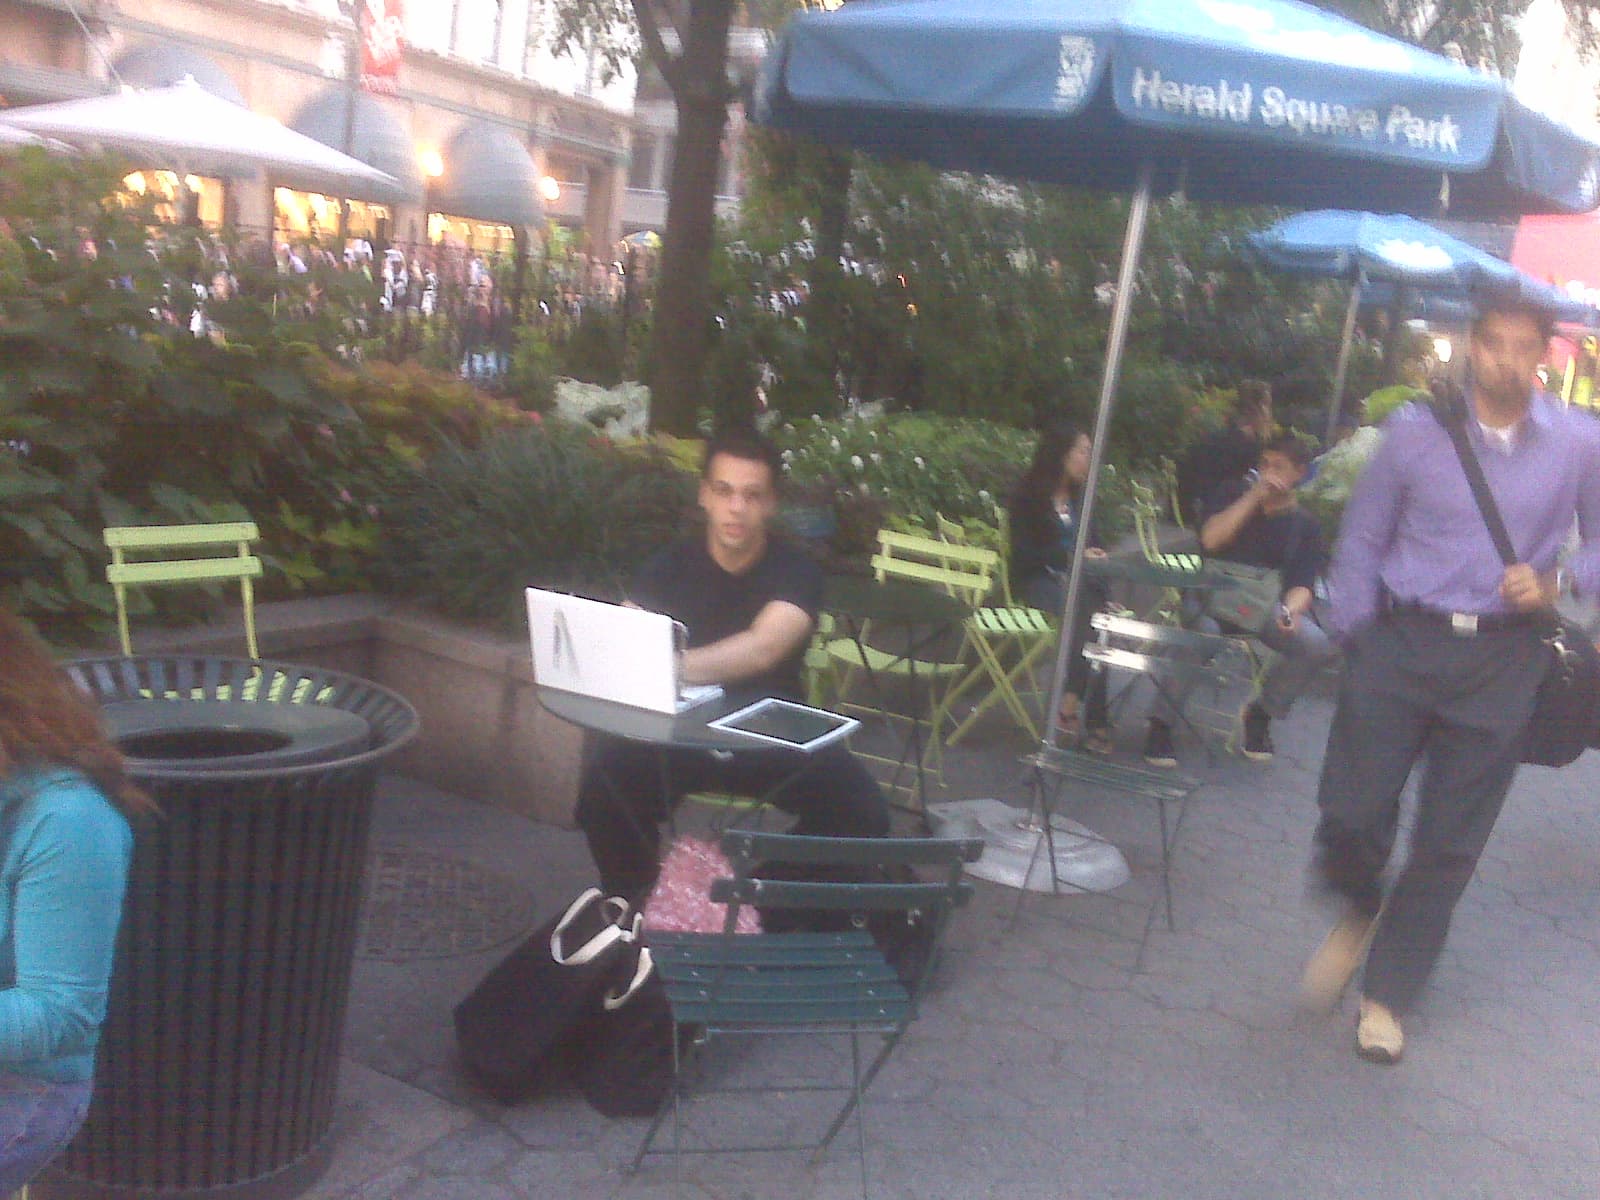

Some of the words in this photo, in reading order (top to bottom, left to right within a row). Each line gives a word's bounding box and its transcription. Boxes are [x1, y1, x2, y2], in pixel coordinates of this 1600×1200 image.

[1131, 66, 1252, 122] Herald
[1259, 86, 1380, 140] Square
[1386, 104, 1461, 155] Park
